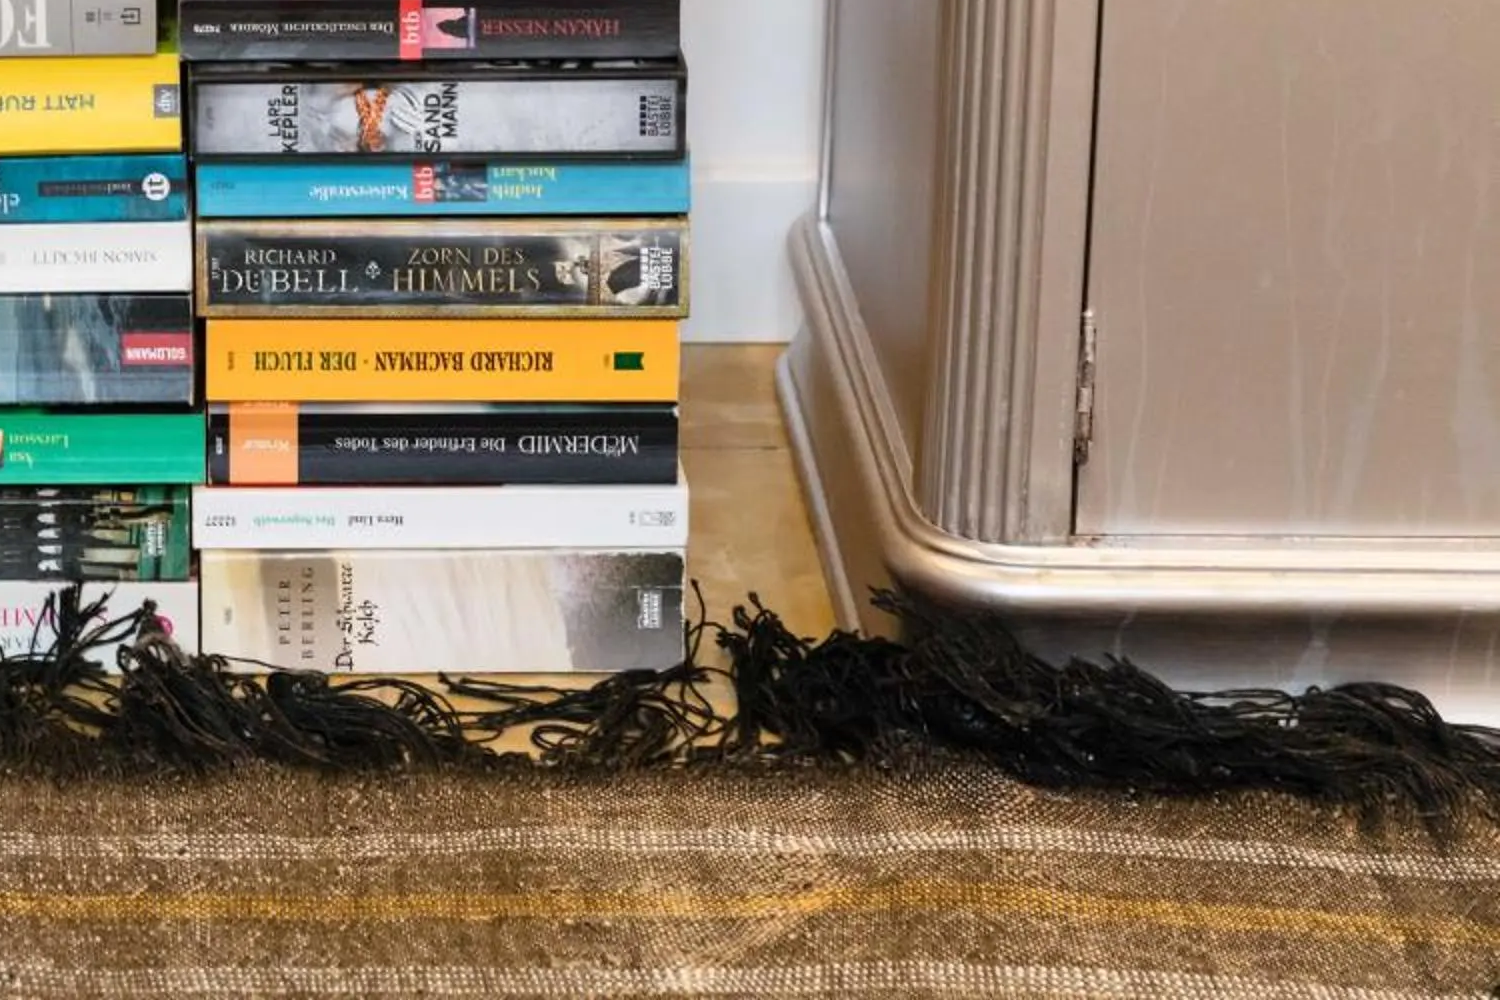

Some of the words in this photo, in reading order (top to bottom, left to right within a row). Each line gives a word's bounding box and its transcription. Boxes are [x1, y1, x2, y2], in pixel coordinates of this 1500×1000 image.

[403, 11, 420, 44] btb
[480, 19, 547, 35] NESSER
[43, 94, 94, 111] MATT
[442, 83, 458, 138] MANN
[268, 98, 281, 137] LARS
[282, 85, 298, 152] KEPLER
[425, 93, 440, 153] SAND
[415, 166, 433, 200] btb
[244, 248, 336, 265] RICHARD
[408, 247, 470, 265] ZORN
[484, 247, 525, 265] DES
[649, 246, 661, 289] BASTEI
[393, 267, 541, 293] HIMMELS
[126, 347, 187, 360] GOLDMANN
[254, 352, 313, 371] FLUCH
[319, 352, 357, 371] DER
[374, 351, 464, 372] BACHMAN
[471, 351, 553, 372] RICHARD
[9, 433, 69, 450] Larsson
[335, 438, 377, 452] Todes
[383, 438, 408, 453] des
[412, 437, 475, 453] Erfinder
[482, 437, 505, 453] Die
[348, 515, 373, 526] Lind
[378, 515, 403, 526] Hera
[278, 580, 291, 645] PETER
[301, 567, 314, 659] BERLING
[357, 600, 379, 646] Kelch
[335, 639, 353, 671] Der
